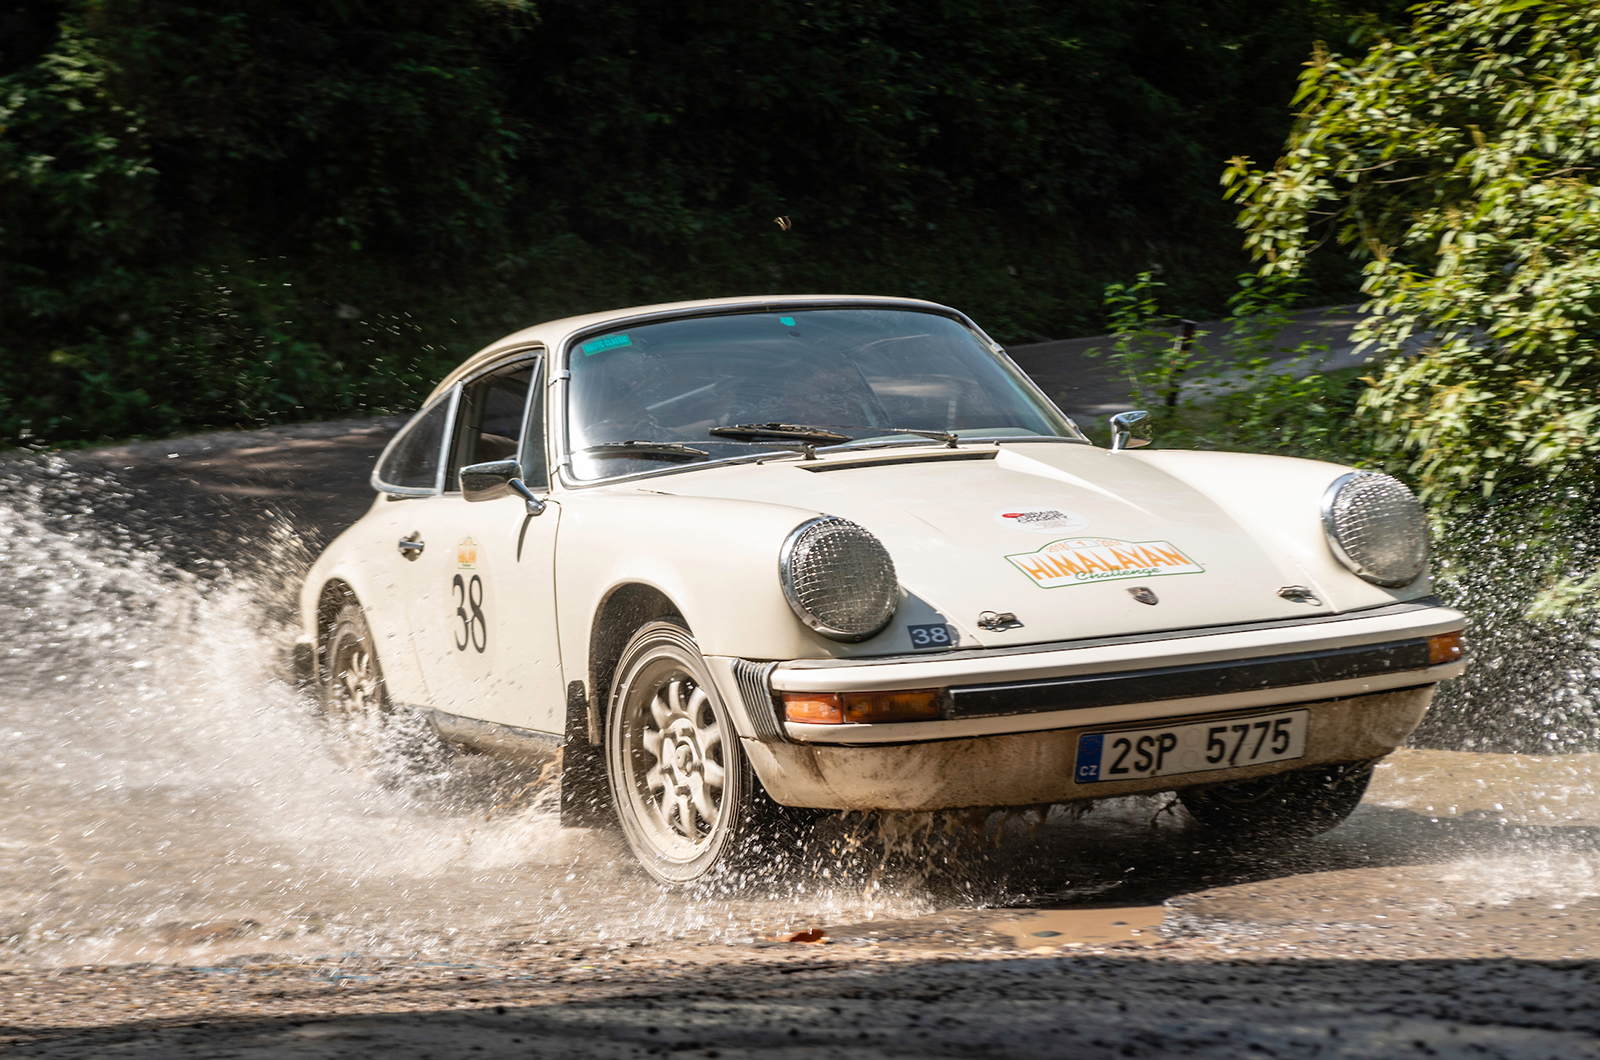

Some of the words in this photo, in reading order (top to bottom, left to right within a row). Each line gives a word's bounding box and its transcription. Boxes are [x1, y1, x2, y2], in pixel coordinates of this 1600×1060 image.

[1012, 544, 1193, 580] HIMALAYAN
[1075, 567, 1162, 581] Challenge
[452, 574, 487, 654] 38
[912, 627, 949, 645] 38
[1109, 732, 1177, 774] 2SP
[1206, 717, 1292, 764] 5775
[1079, 765, 1098, 776] CZ
